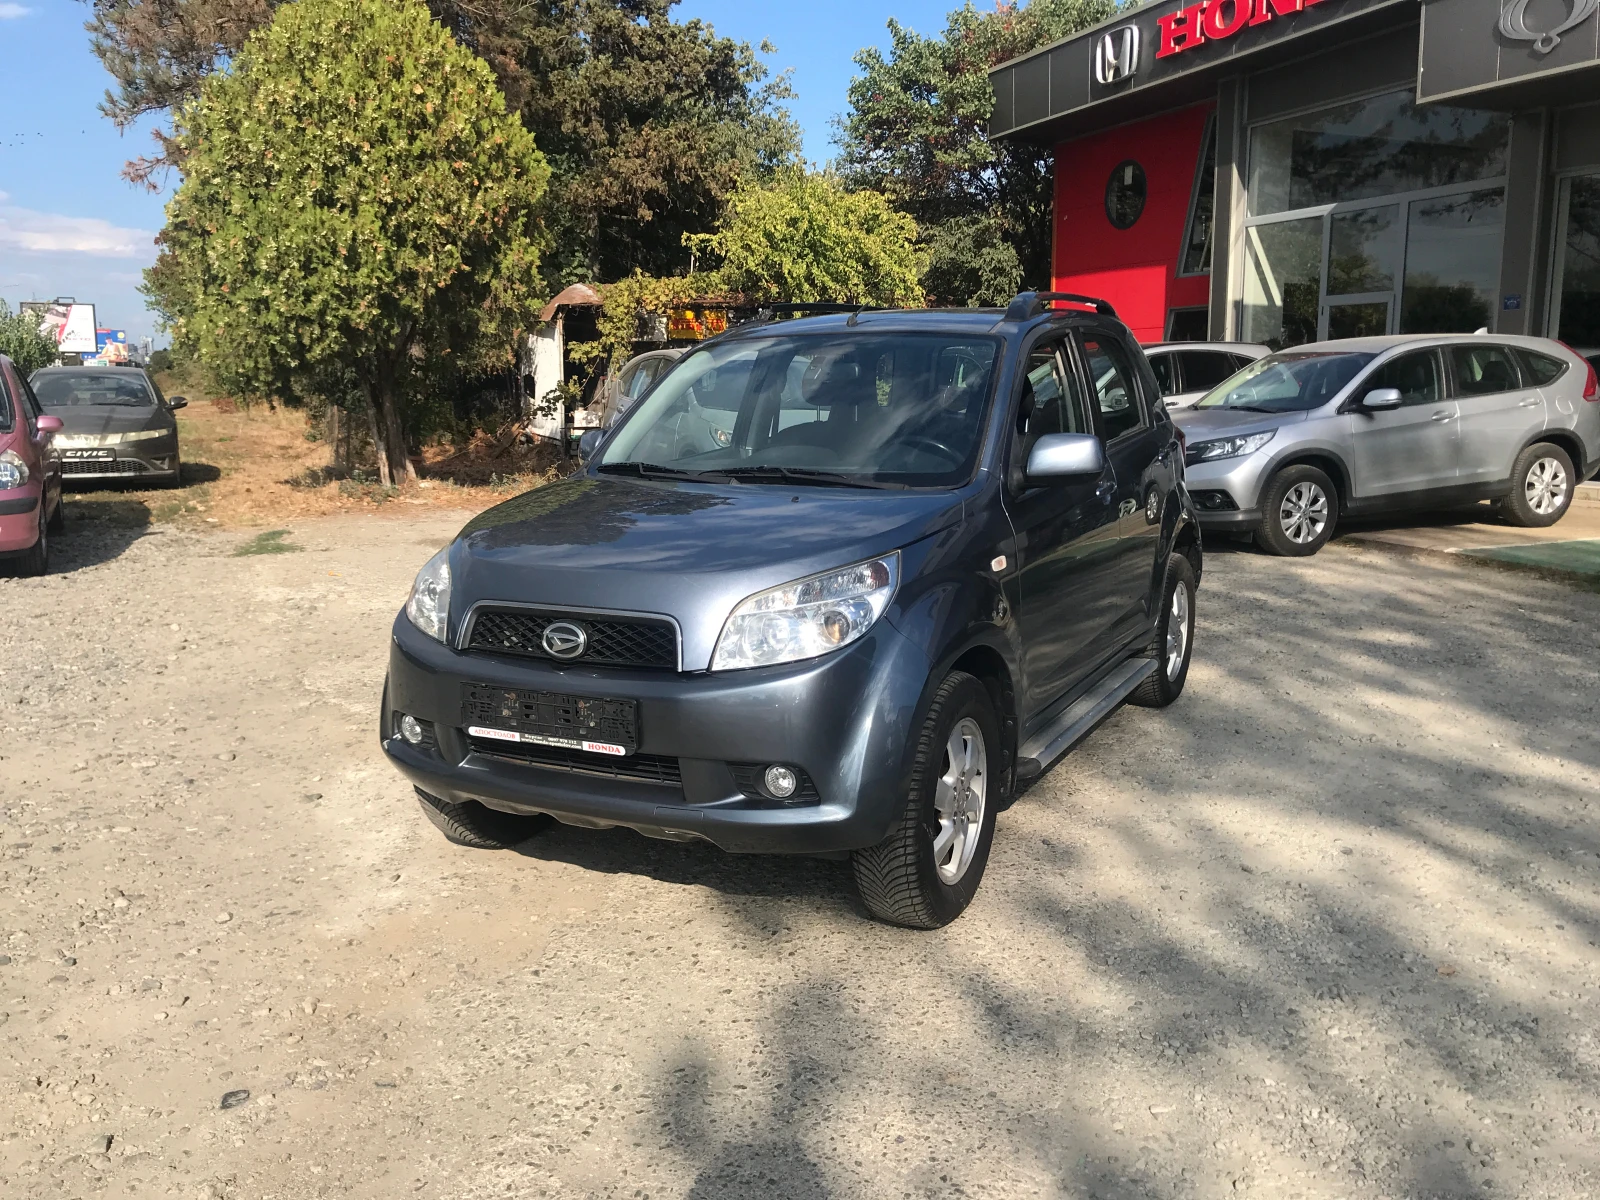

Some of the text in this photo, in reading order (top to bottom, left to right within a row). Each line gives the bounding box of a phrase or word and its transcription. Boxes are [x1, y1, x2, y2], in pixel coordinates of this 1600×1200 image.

[65, 450, 108, 458] CIVIC
[474, 729, 516, 739] АПОСТОЛОВ
[588, 743, 621, 754] HONDA
